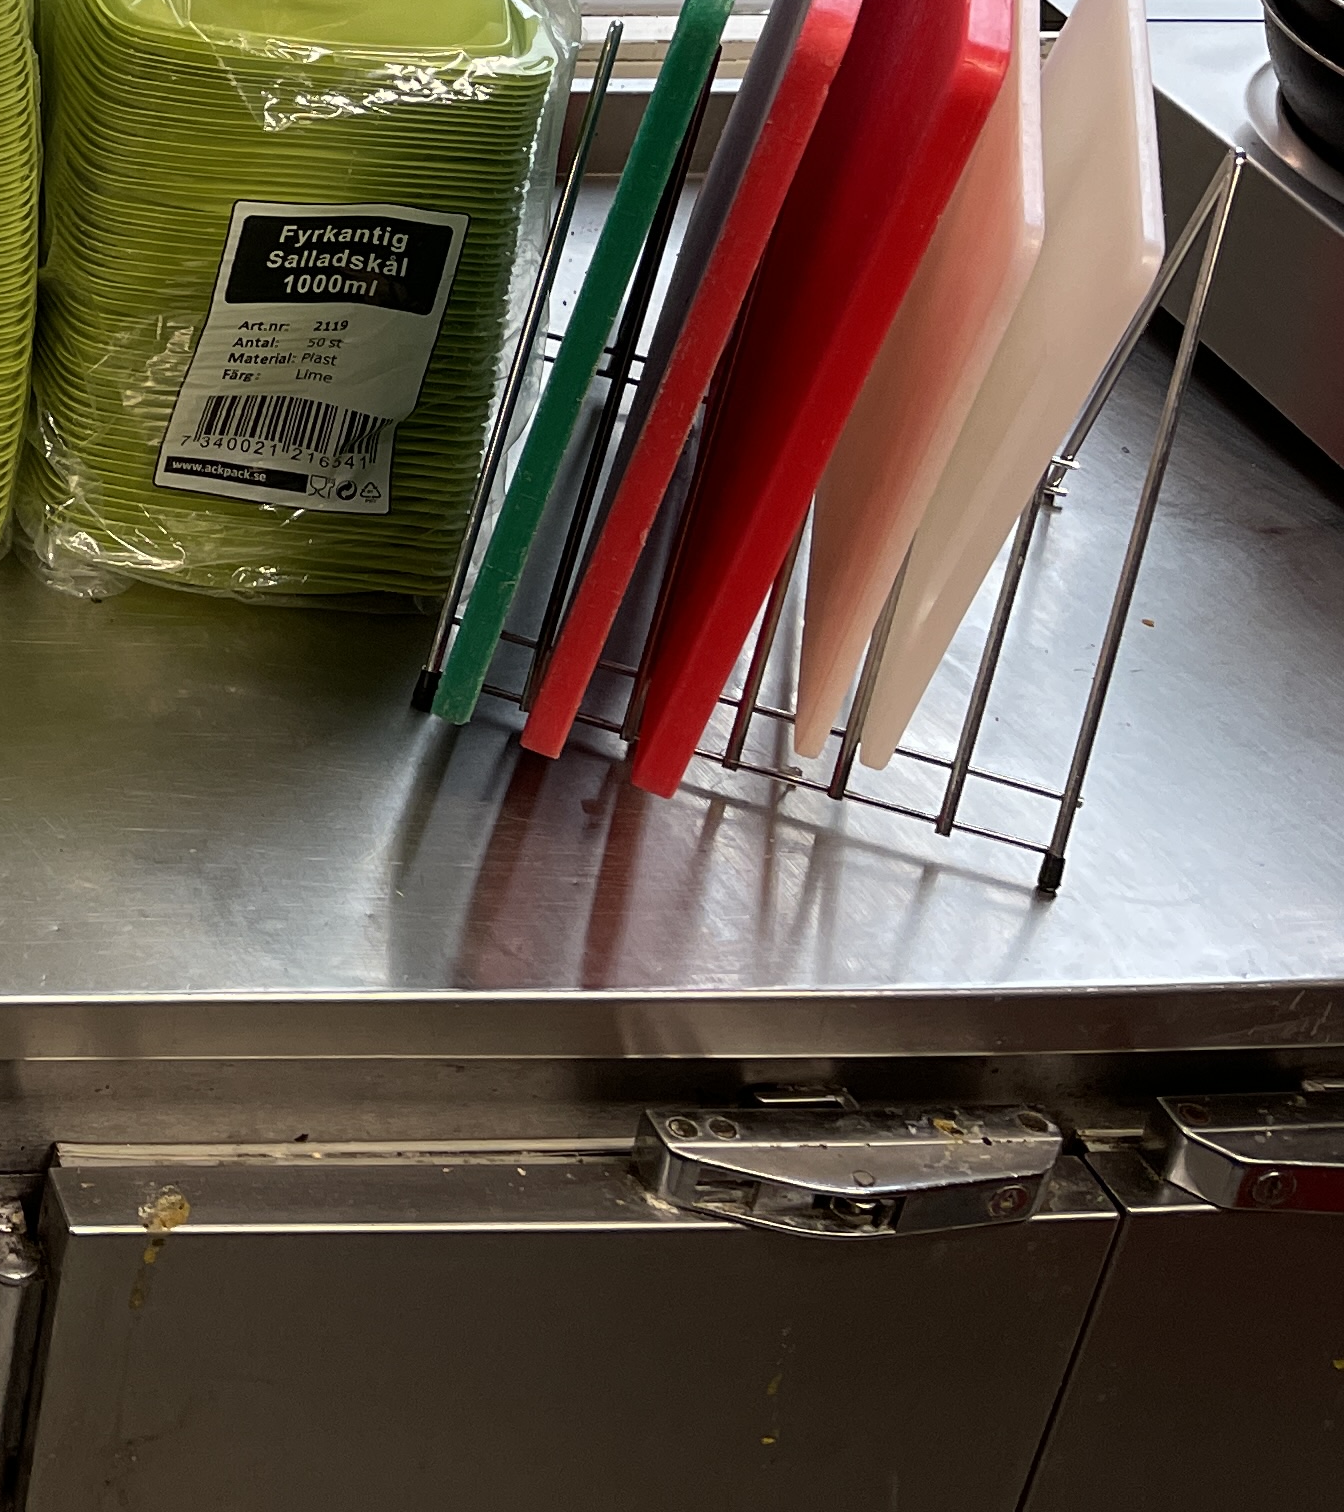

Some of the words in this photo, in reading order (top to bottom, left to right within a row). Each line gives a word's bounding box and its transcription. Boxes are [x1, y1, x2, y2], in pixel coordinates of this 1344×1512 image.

[279, 224, 409, 253] Fyrkantig
[266, 250, 409, 278] Salladskål
[283, 274, 378, 297] 1000ml
[238, 320, 290, 332] Art.nr:
[313, 320, 349, 332] 2119
[232, 337, 279, 349] Antal:
[328, 337, 345, 349] st
[227, 352, 298, 365] Material:
[301, 352, 337, 366] Plast
[295, 369, 333, 383] Lime
[180, 435, 192, 447] 7
[200, 437, 278, 456] 340021
[172, 459, 267, 482] www.ackpack.se
